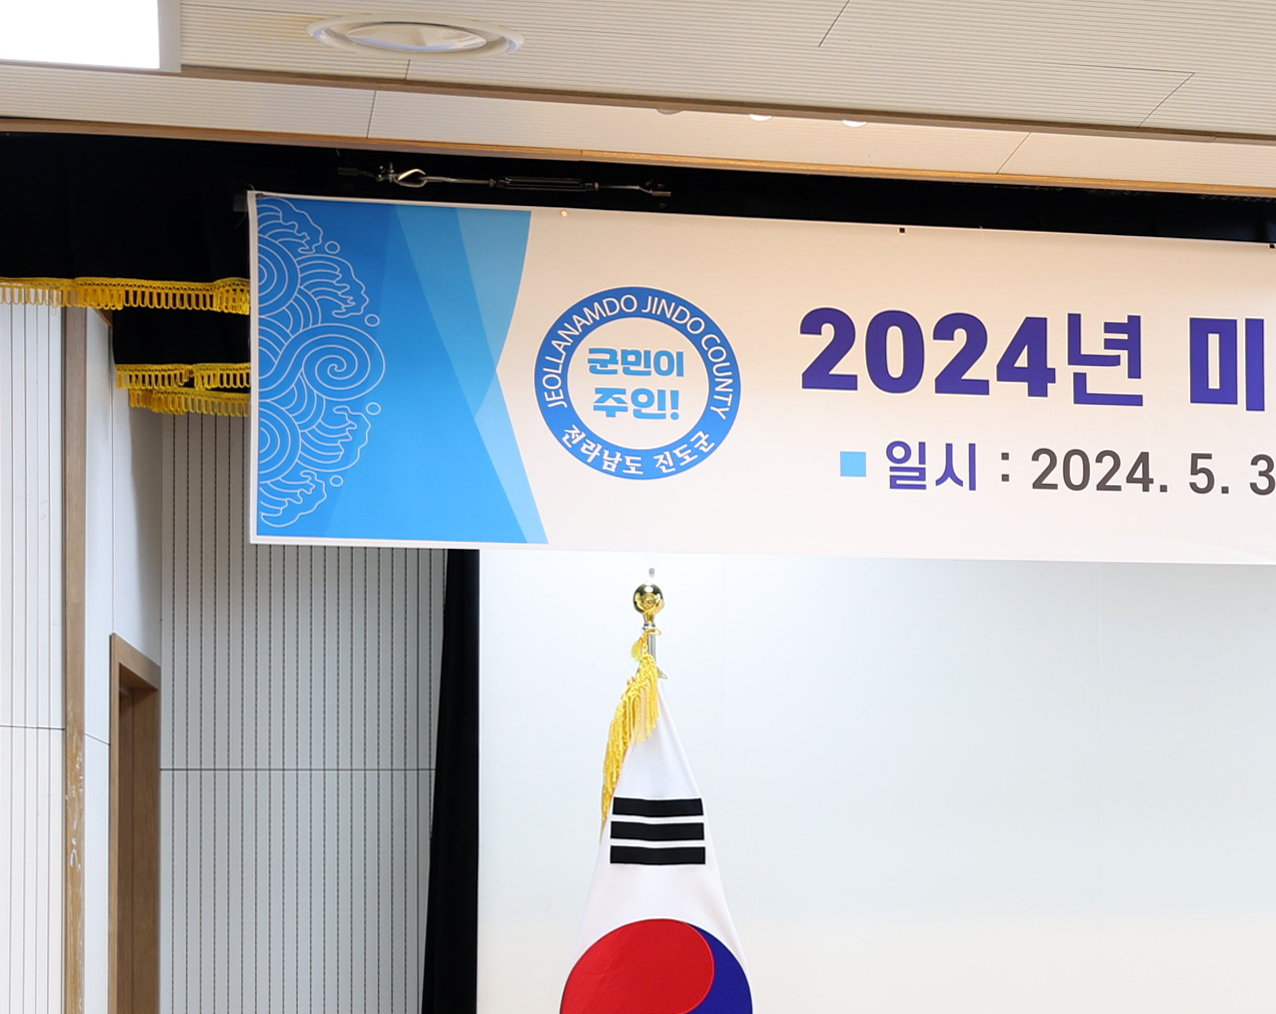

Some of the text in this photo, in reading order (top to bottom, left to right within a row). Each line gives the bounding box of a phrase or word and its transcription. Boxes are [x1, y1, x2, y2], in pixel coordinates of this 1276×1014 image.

[542, 294, 734, 420] JEOLLANAMDO JINDO COUNTY
[587, 347, 685, 377] 군민이
[799, 307, 1144, 407] 2024년
[593, 387, 680, 421] 주인!
[562, 424, 715, 475] 전라남도 진도군
[885, 440, 977, 491] 일시
[1031, 447, 1168, 493] 2024.
[1189, 452, 1230, 495] 5.
